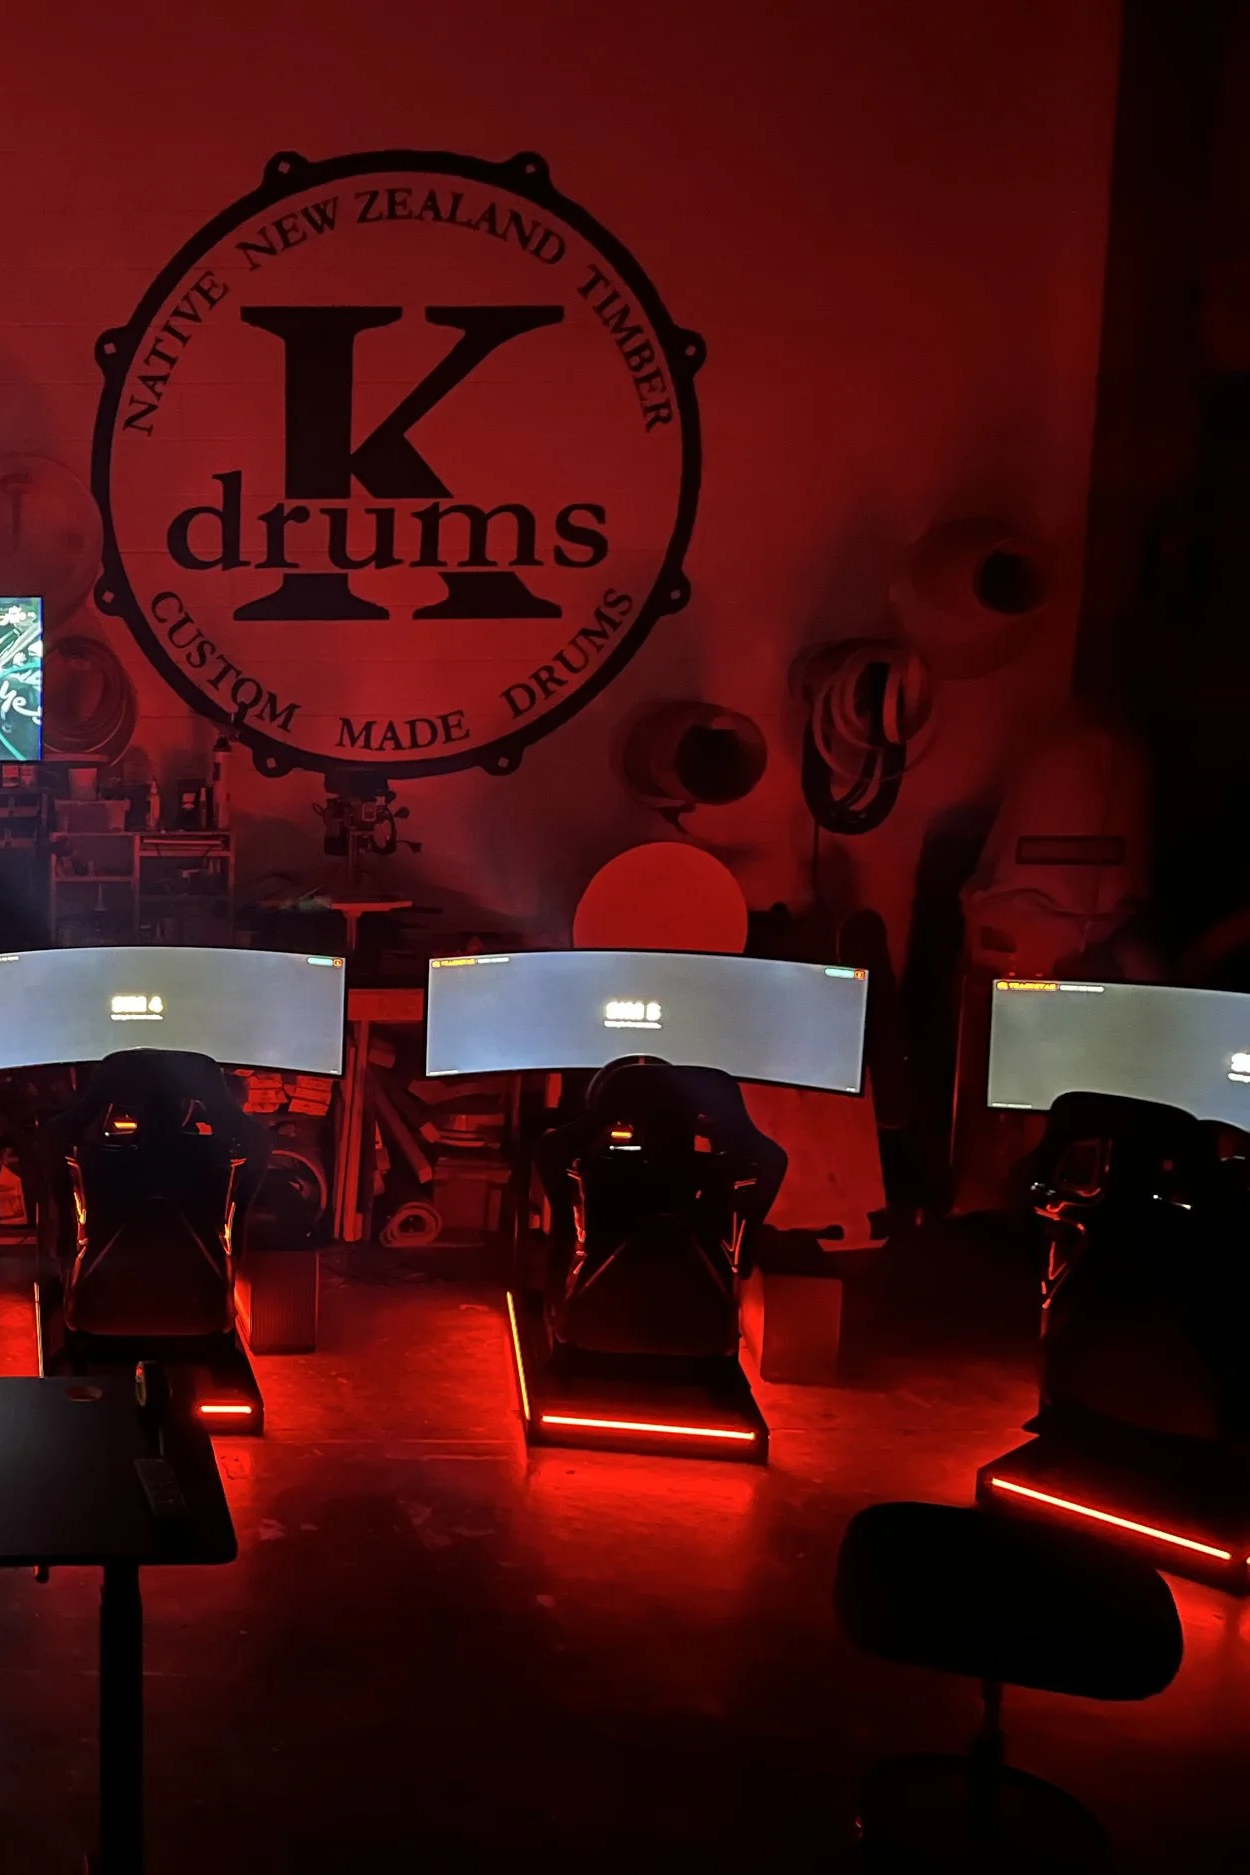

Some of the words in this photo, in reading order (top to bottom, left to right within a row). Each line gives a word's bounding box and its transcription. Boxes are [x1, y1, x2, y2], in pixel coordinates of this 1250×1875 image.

[124, 269, 230, 437] NATIVE
[235, 195, 340, 271] NEW
[354, 187, 567, 267] ZEALAND
[576, 263, 674, 433] TIMBER
[166, 469, 610, 571] drums
[232, 304, 565, 622] K
[0, 680, 41, 725] ye
[150, 590, 301, 734] CUSTOM
[336, 709, 471, 752] MADE
[499, 587, 635, 719] DRUMS
